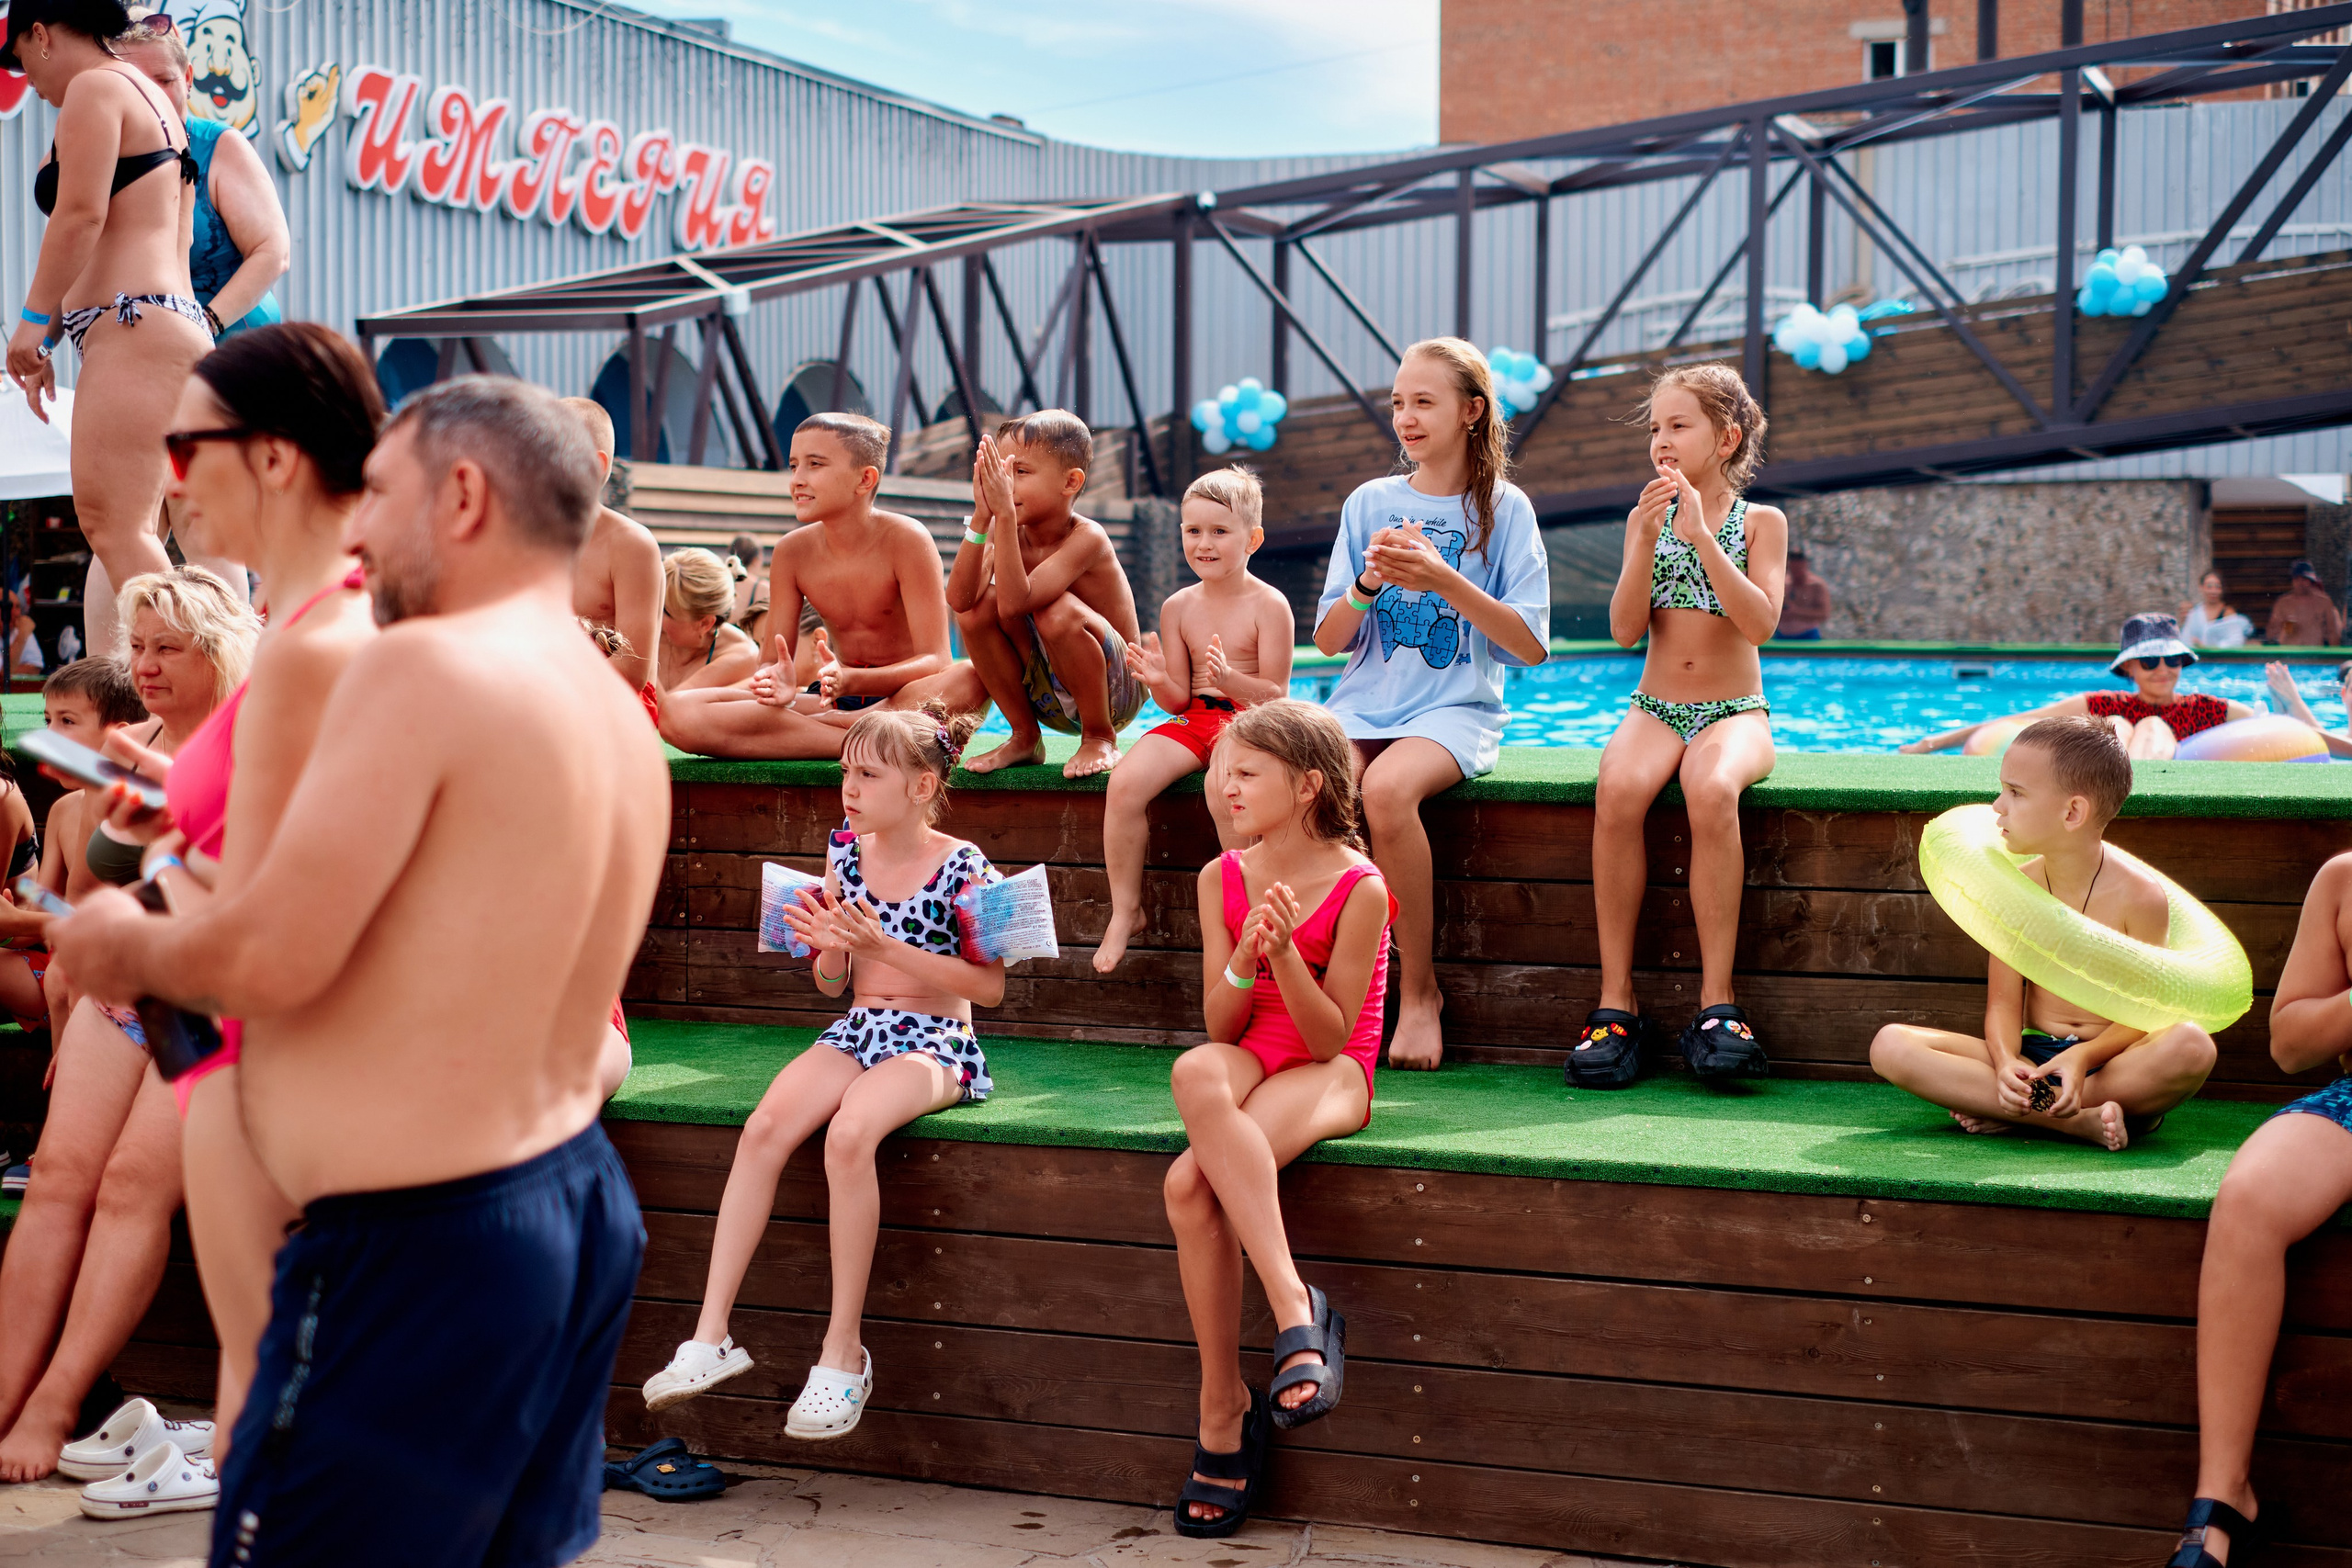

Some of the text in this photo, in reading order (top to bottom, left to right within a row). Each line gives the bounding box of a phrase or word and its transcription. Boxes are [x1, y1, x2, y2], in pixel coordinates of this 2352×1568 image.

[348, 66, 775, 250] ИМПЕРИЯ
[1388, 513, 1404, 523] Onc
[1425, 517, 1447, 527] while
